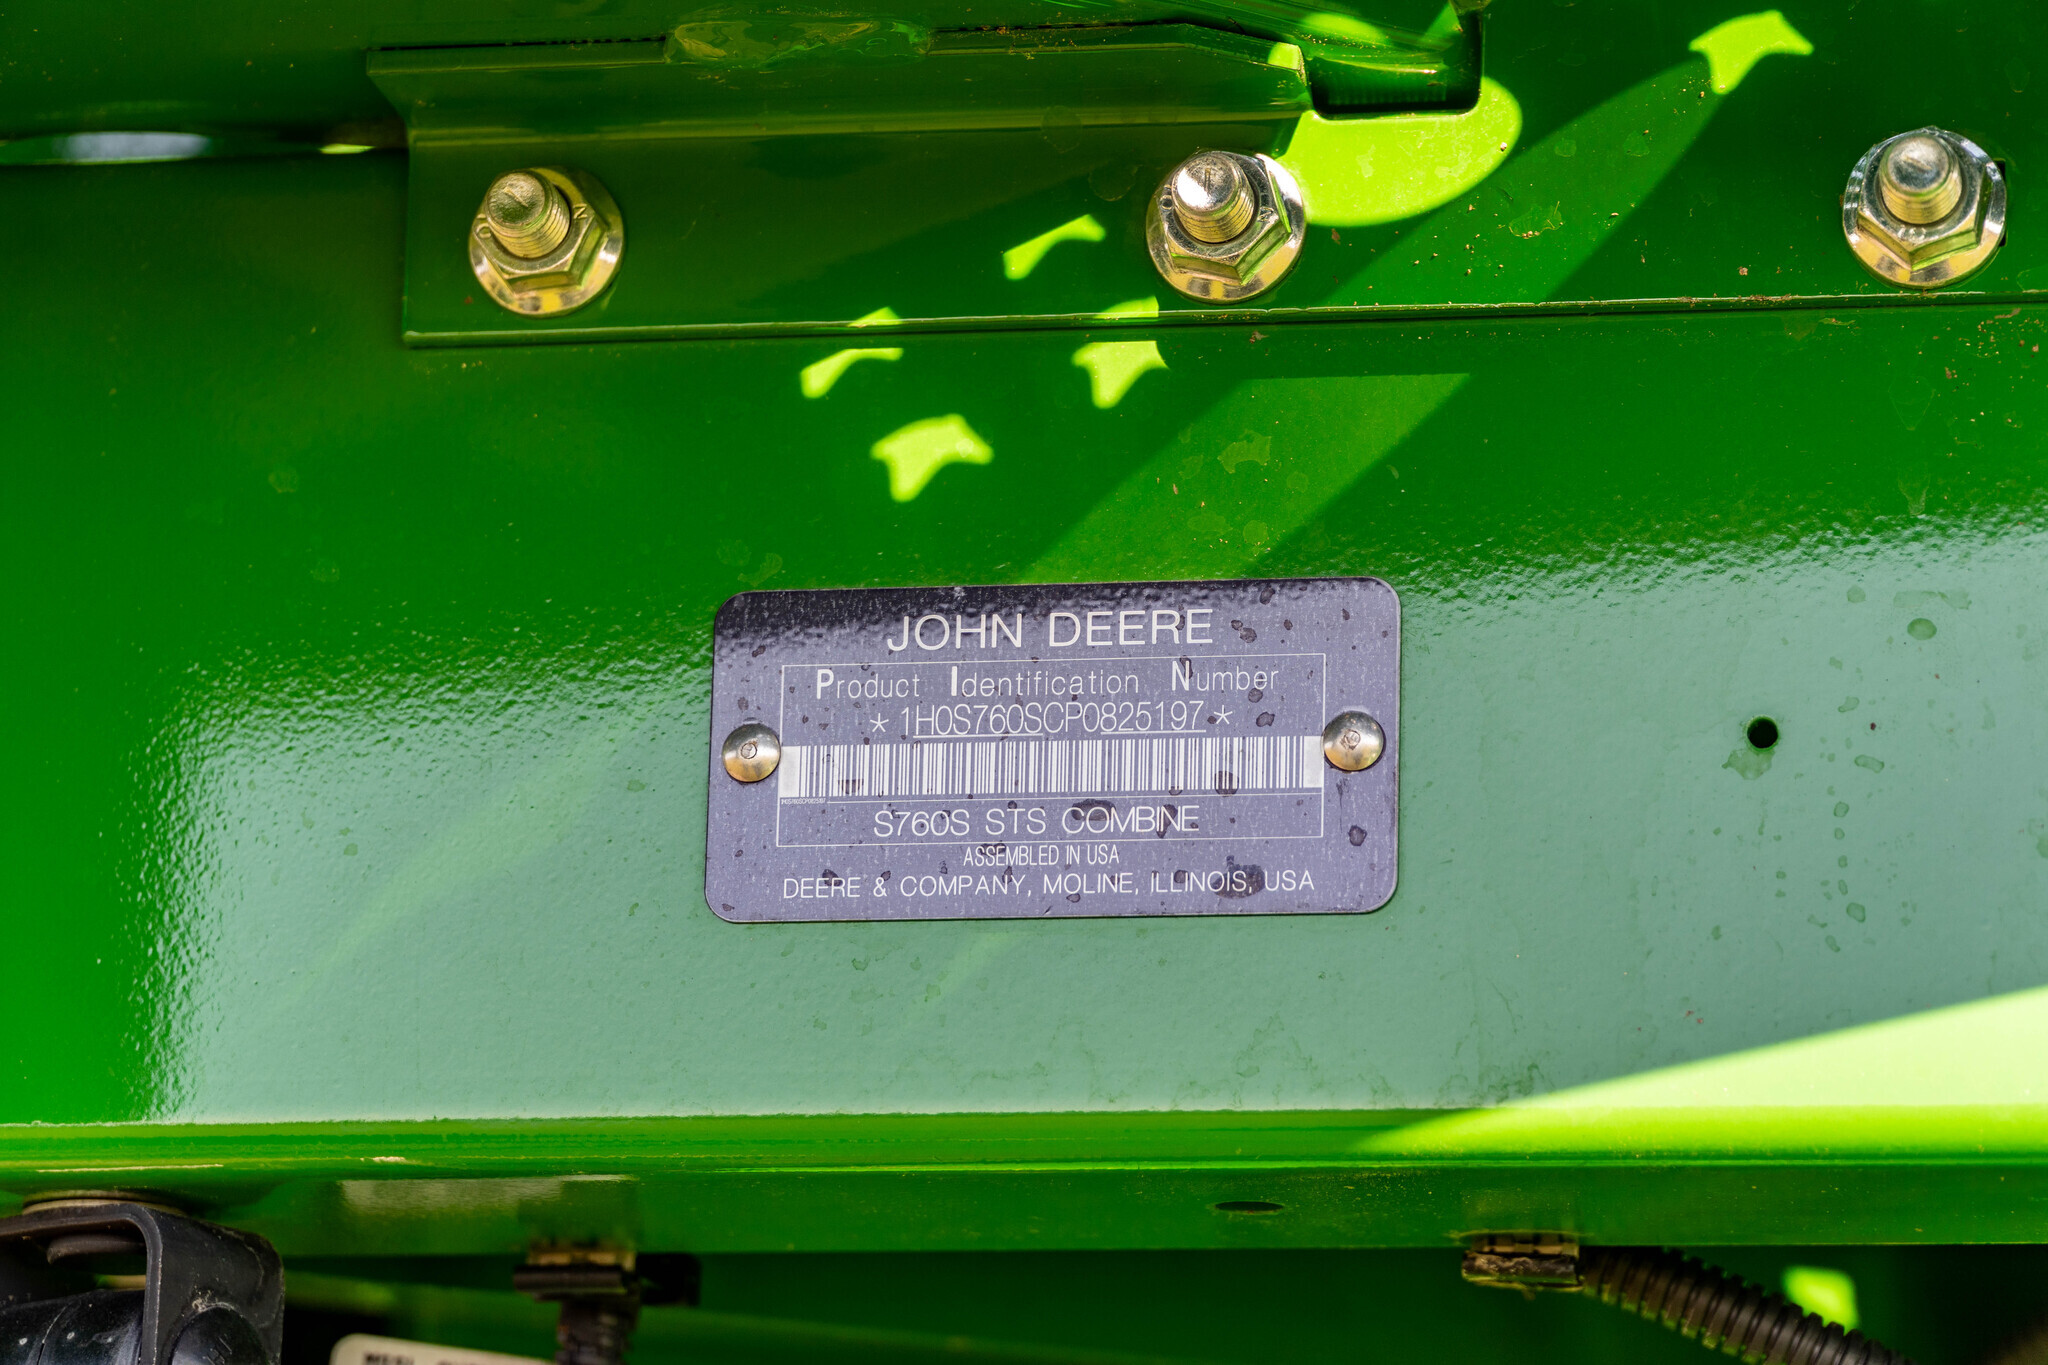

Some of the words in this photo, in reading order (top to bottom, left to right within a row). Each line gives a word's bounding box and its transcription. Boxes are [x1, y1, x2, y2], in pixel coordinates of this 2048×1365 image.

[887, 613, 1022, 651] JOHN
[1049, 609, 1213, 647] DEERE
[816, 668, 920, 700] Product
[950, 665, 1140, 698] Identification
[1171, 660, 1279, 691] Number
[873, 808, 970, 837] S760S
[985, 807, 1047, 836] STS
[1061, 805, 1200, 834] COMBINE
[963, 844, 1060, 867] ASSEMBLED
[1066, 844, 1080, 866] IN
[1087, 843, 1120, 865] USA
[783, 877, 862, 899] DEERE
[872, 876, 888, 898] &
[900, 874, 1032, 898] COMPANY,
[1043, 872, 1139, 896] MOLINE,
[1150, 870, 1253, 894] ILLINOIS,
[1264, 869, 1315, 891] USA
